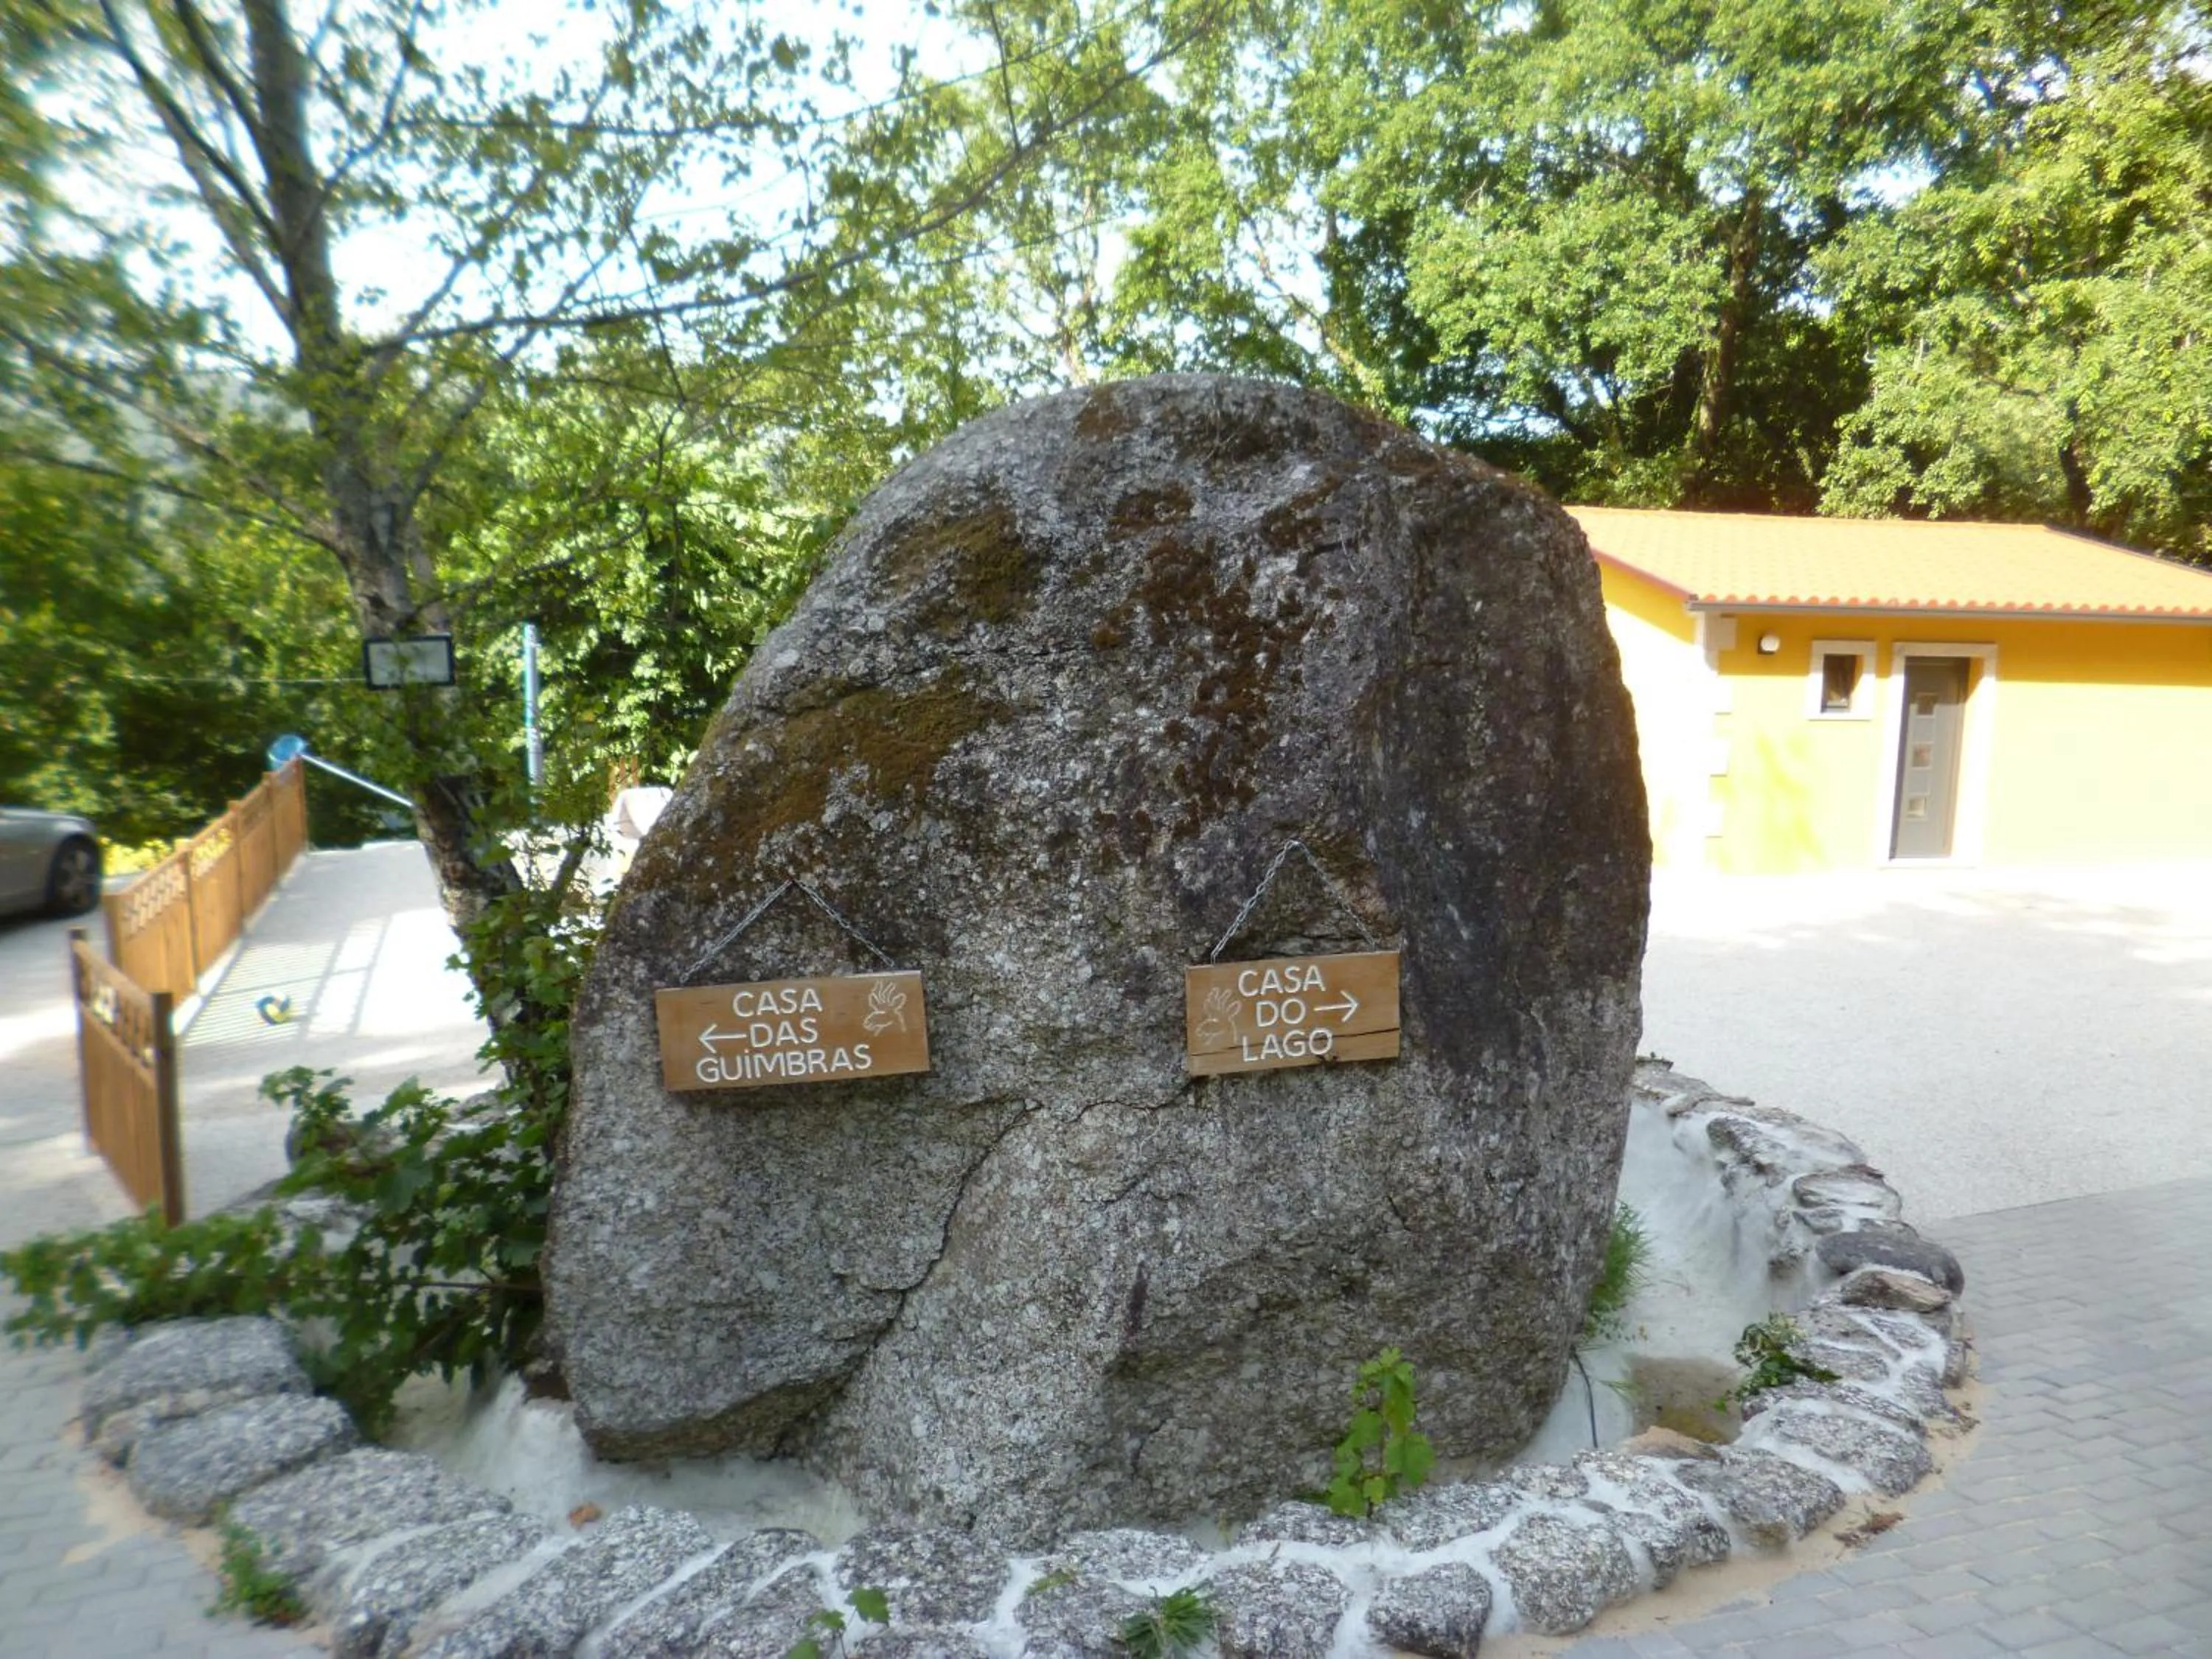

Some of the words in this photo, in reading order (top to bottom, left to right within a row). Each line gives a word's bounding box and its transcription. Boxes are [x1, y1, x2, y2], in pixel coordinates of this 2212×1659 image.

[1238, 964, 1326, 997] CASA
[732, 988, 823, 1018] CASA
[1256, 998, 1306, 1027] DO
[749, 1018, 818, 1048] DAS
[1242, 1027, 1333, 1062] LAGO
